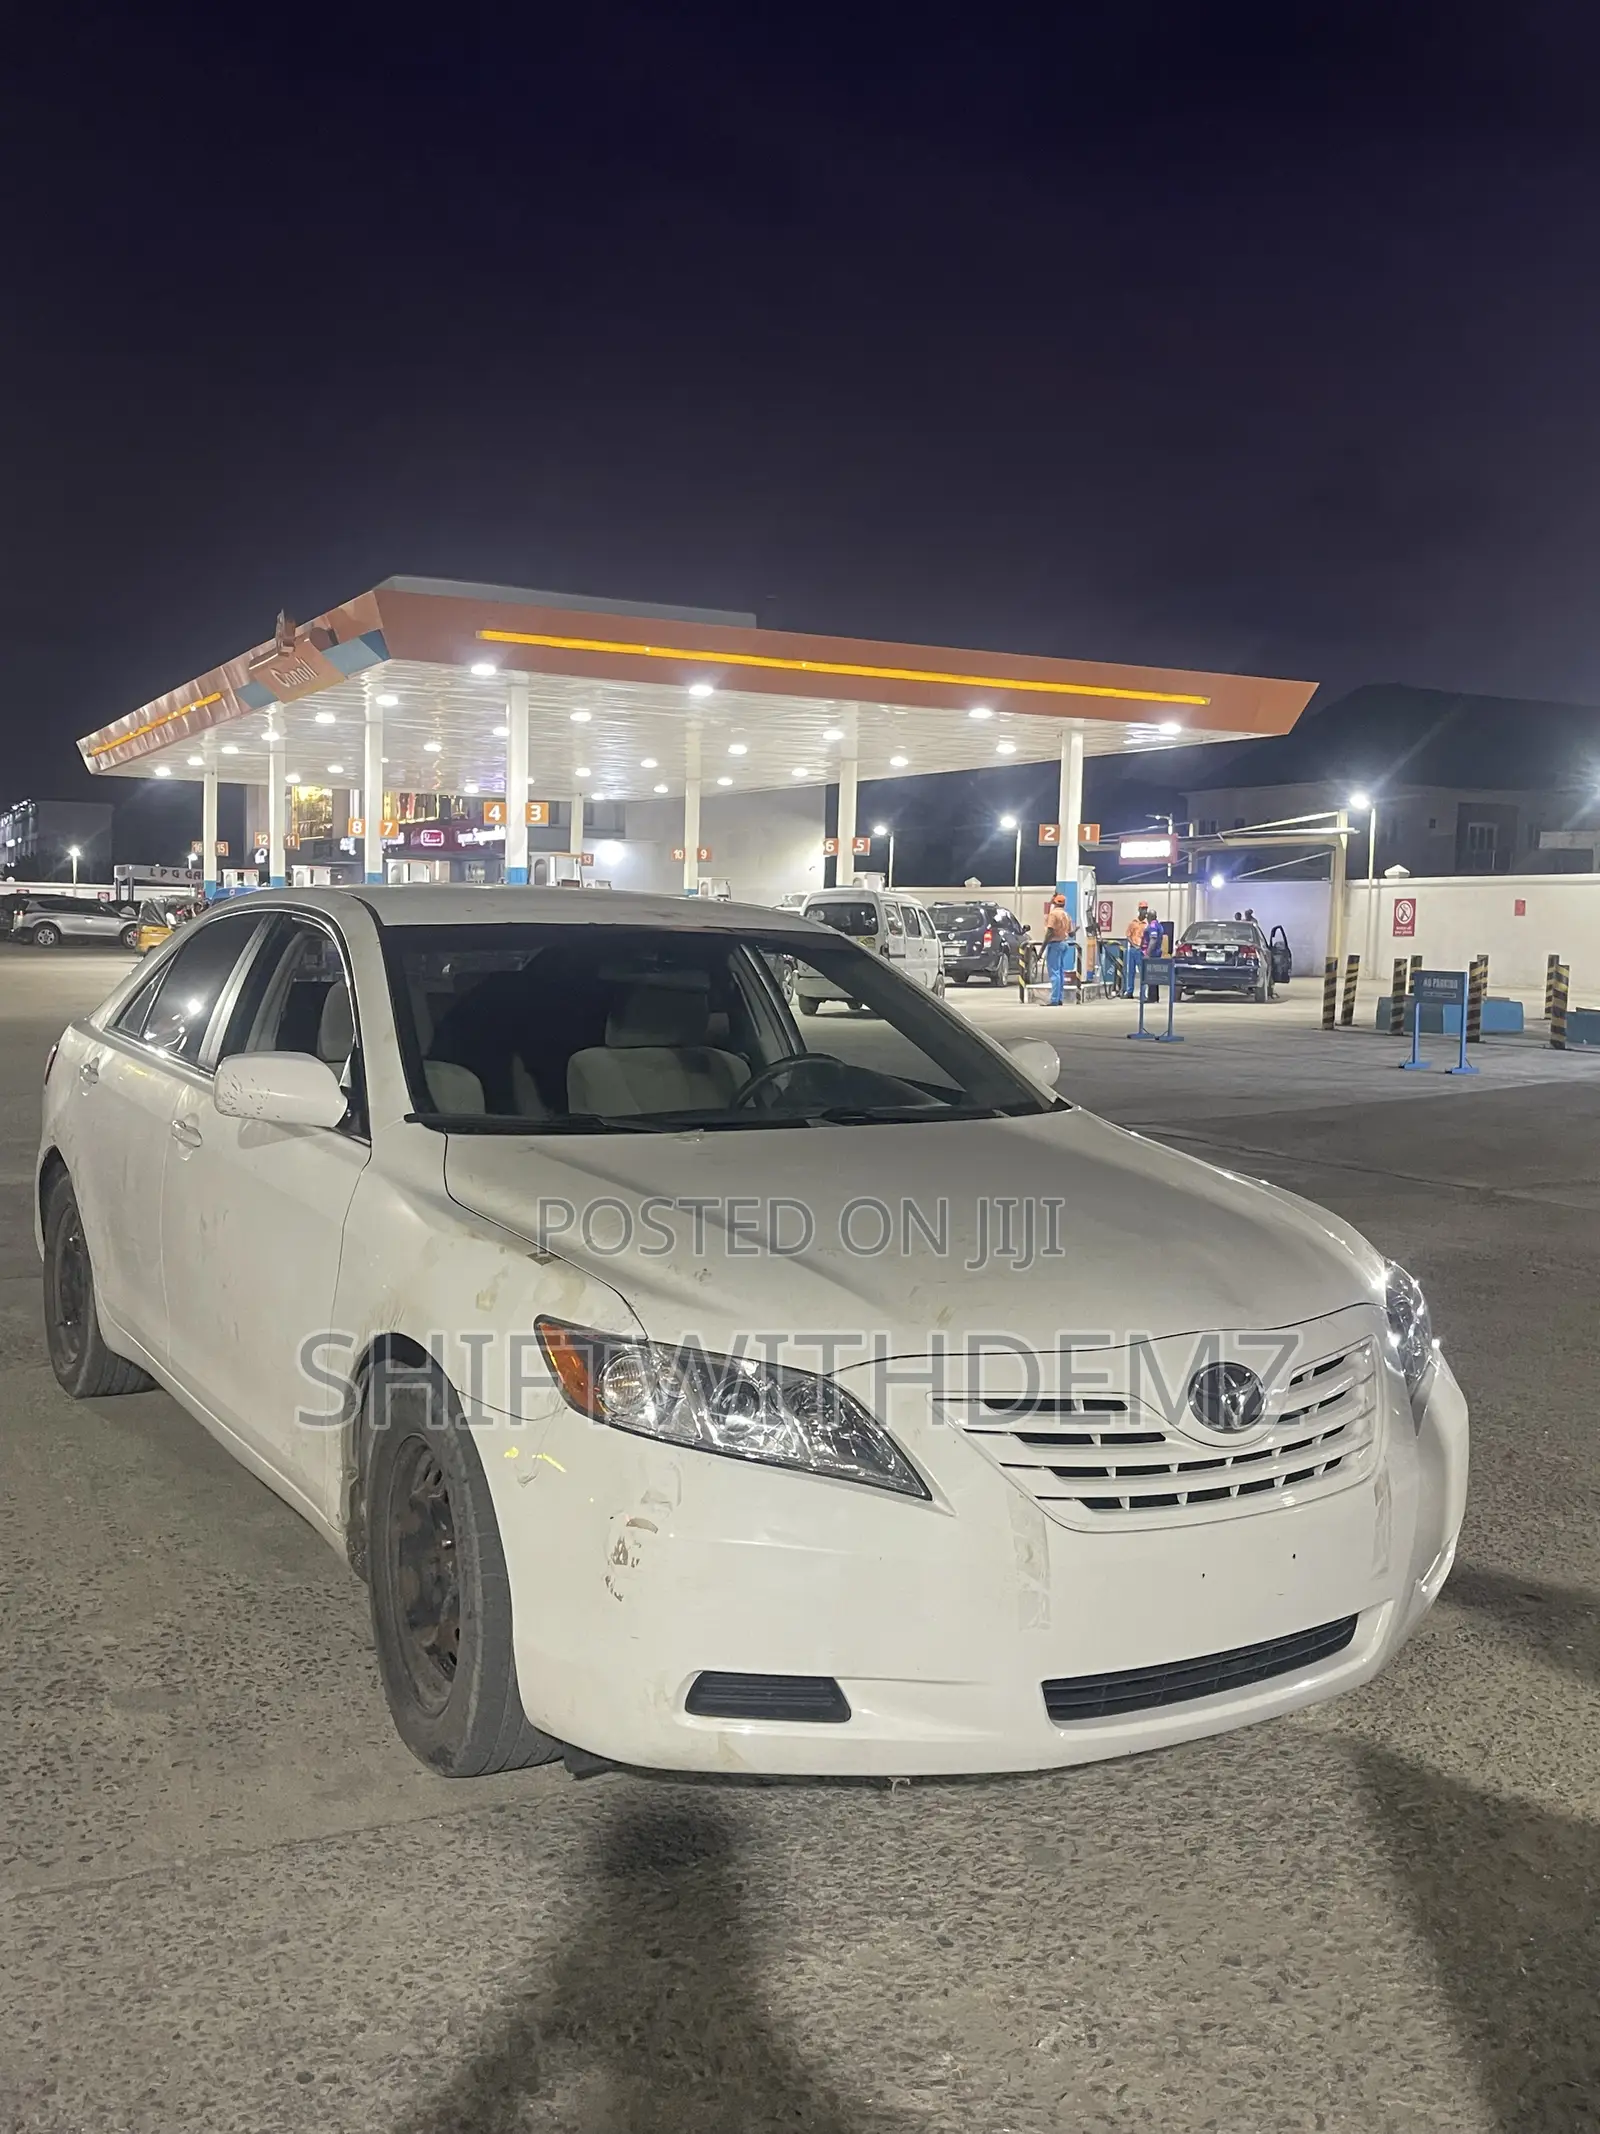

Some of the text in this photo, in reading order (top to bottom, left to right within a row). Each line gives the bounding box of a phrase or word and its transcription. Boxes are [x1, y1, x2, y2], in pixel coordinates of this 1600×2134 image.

[488, 804, 501, 821] 4
[530, 804, 542, 821] 3
[352, 821, 363, 834] 8
[383, 822, 393, 836] 7
[1083, 827, 1091, 840] 1
[256, 834, 269, 846] 12
[1043, 827, 1055, 841] 2
[285, 836, 296, 847] 11
[825, 840, 835, 852] 6
[855, 840, 865, 852] 5
[216, 844, 226, 853] 15
[673, 849, 683, 859] 10
[699, 849, 707, 859] 9
[185, 869, 202, 880] GA
